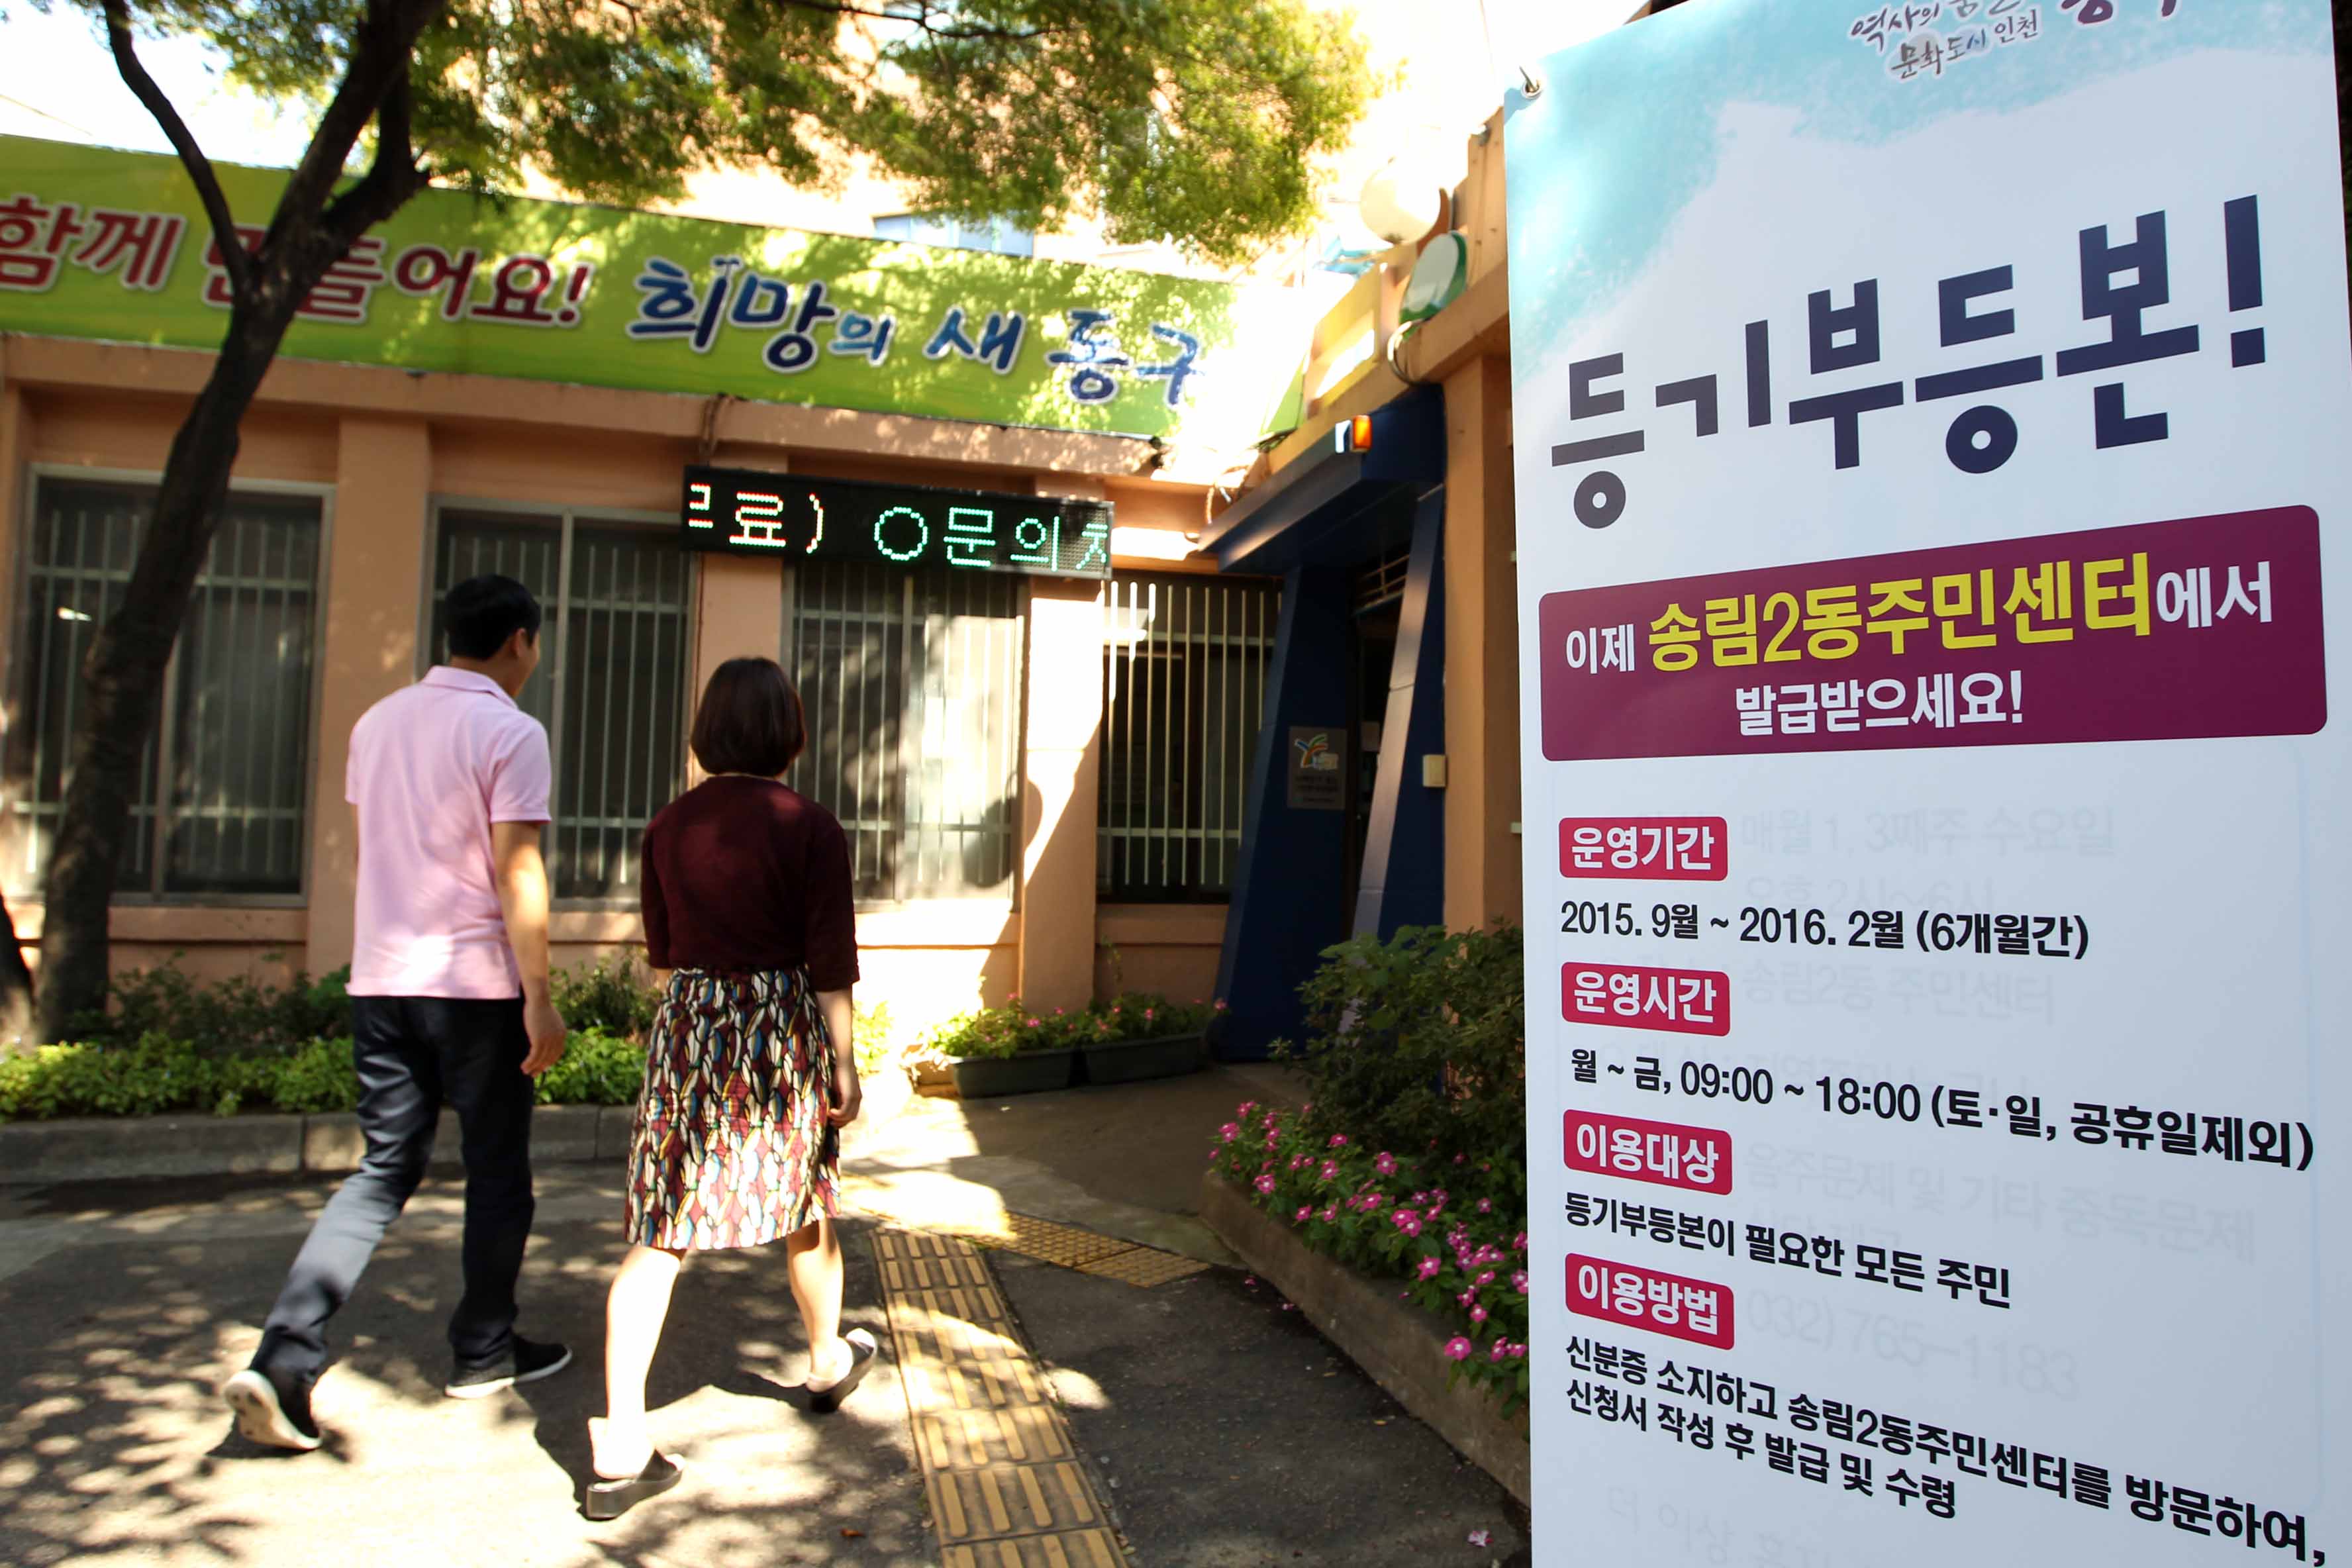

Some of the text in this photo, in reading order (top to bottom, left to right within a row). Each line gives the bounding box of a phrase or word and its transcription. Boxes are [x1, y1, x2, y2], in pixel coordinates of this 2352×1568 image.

[1851, 5, 1939, 51] 역사의
[1890, 28, 1986, 79] 문화도시
[1994, 9, 2038, 44] 인천
[0, 196, 184, 290] 함께
[628, 256, 894, 369] 희망의
[926, 306, 1024, 374] 새
[1551, 195, 2267, 529] 등기부등본!
[1565, 552, 2273, 674] 이제 송림2동주민센터에서
[1735, 669, 2023, 737] 발급받으세요!
[1571, 825, 1715, 871] 운영기간
[1561, 901, 1642, 936] 2015.
[1651, 904, 1698, 940] 9월
[1740, 906, 1836, 946] 2016.
[1848, 910, 1904, 949] 2월
[1916, 910, 2089, 960] (6개월간)
[1573, 970, 1718, 1024] 운영시간
[1571, 1049, 1596, 1084] 월
[1634, 1056, 1671, 1095] 금,
[1681, 1061, 1773, 1104] 09:00
[1816, 1076, 1921, 1122] 18:00
[2071, 1102, 2314, 1171] 공휴일제외)
[1576, 1123, 1720, 1185] 이용대상
[1565, 1192, 1734, 1257] 등기부등본이
[1745, 1224, 1845, 1277] 필요한
[1855, 1244, 1925, 1293] 모든
[1937, 1258, 2010, 1309] 주민
[1578, 1264, 1719, 1334] 이용방법
[1566, 1379, 1955, 1519] 신청서 작성 후 발급 및 수령
[1566, 1336, 2326, 1567] 신분증 소지하고 송림2동주민센터를 방문하여,
